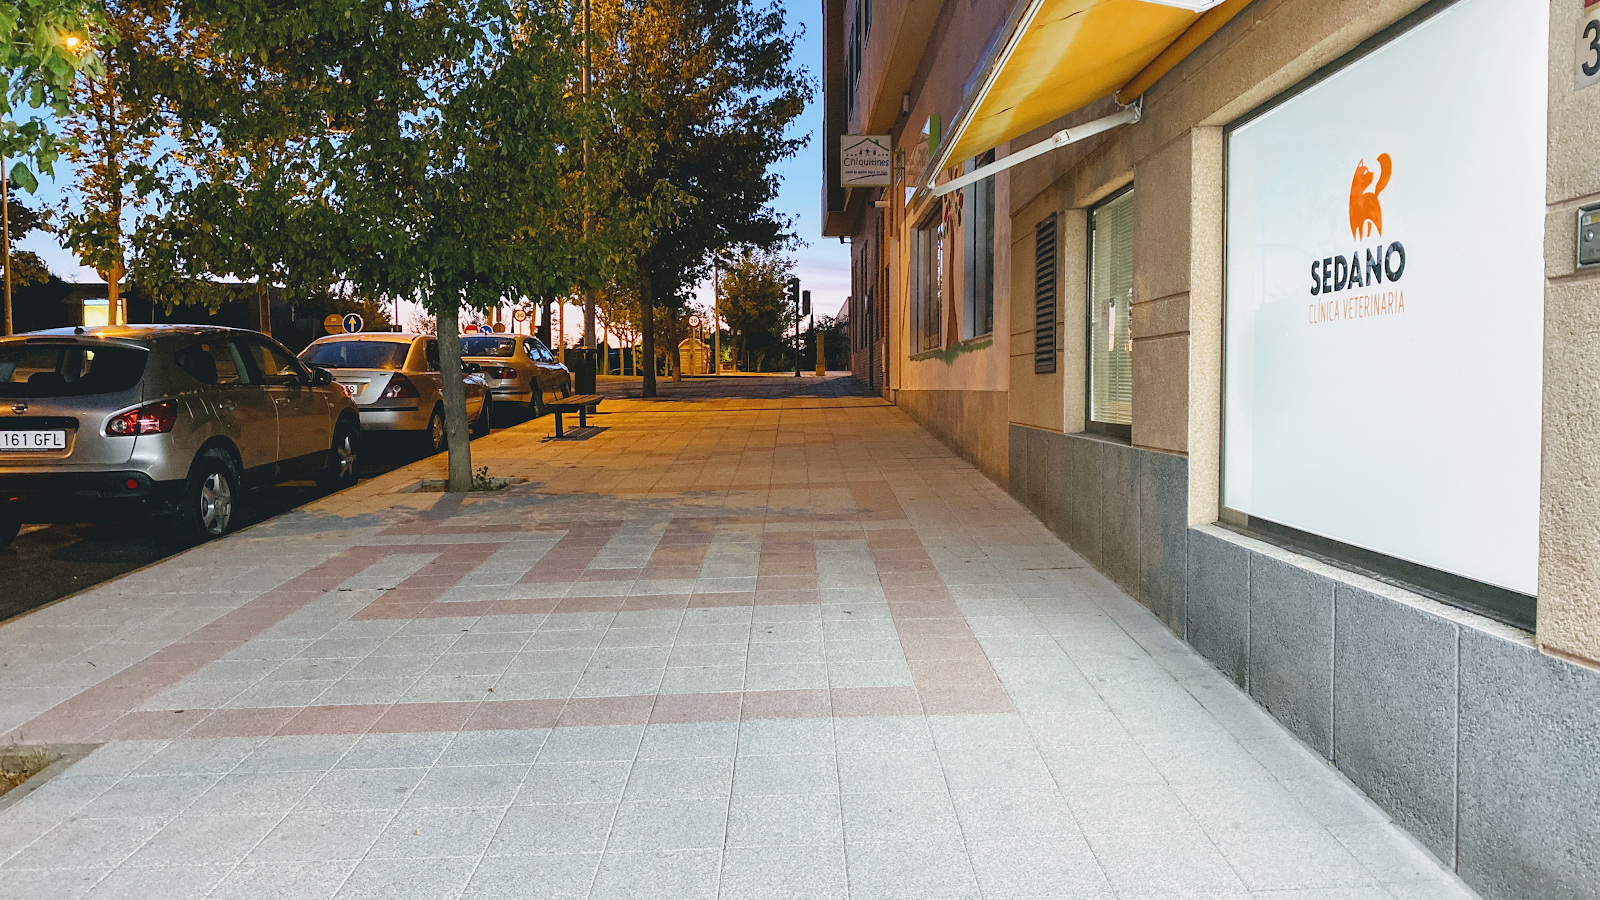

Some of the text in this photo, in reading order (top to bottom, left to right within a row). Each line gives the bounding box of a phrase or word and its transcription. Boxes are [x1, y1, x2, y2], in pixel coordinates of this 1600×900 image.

[843, 157, 889, 167] Chiquitines
[1310, 241, 1406, 296] SEDANO
[1309, 290, 1405, 324] CLÍNICA VETERINARIA
[34, 433, 62, 446] GFL
